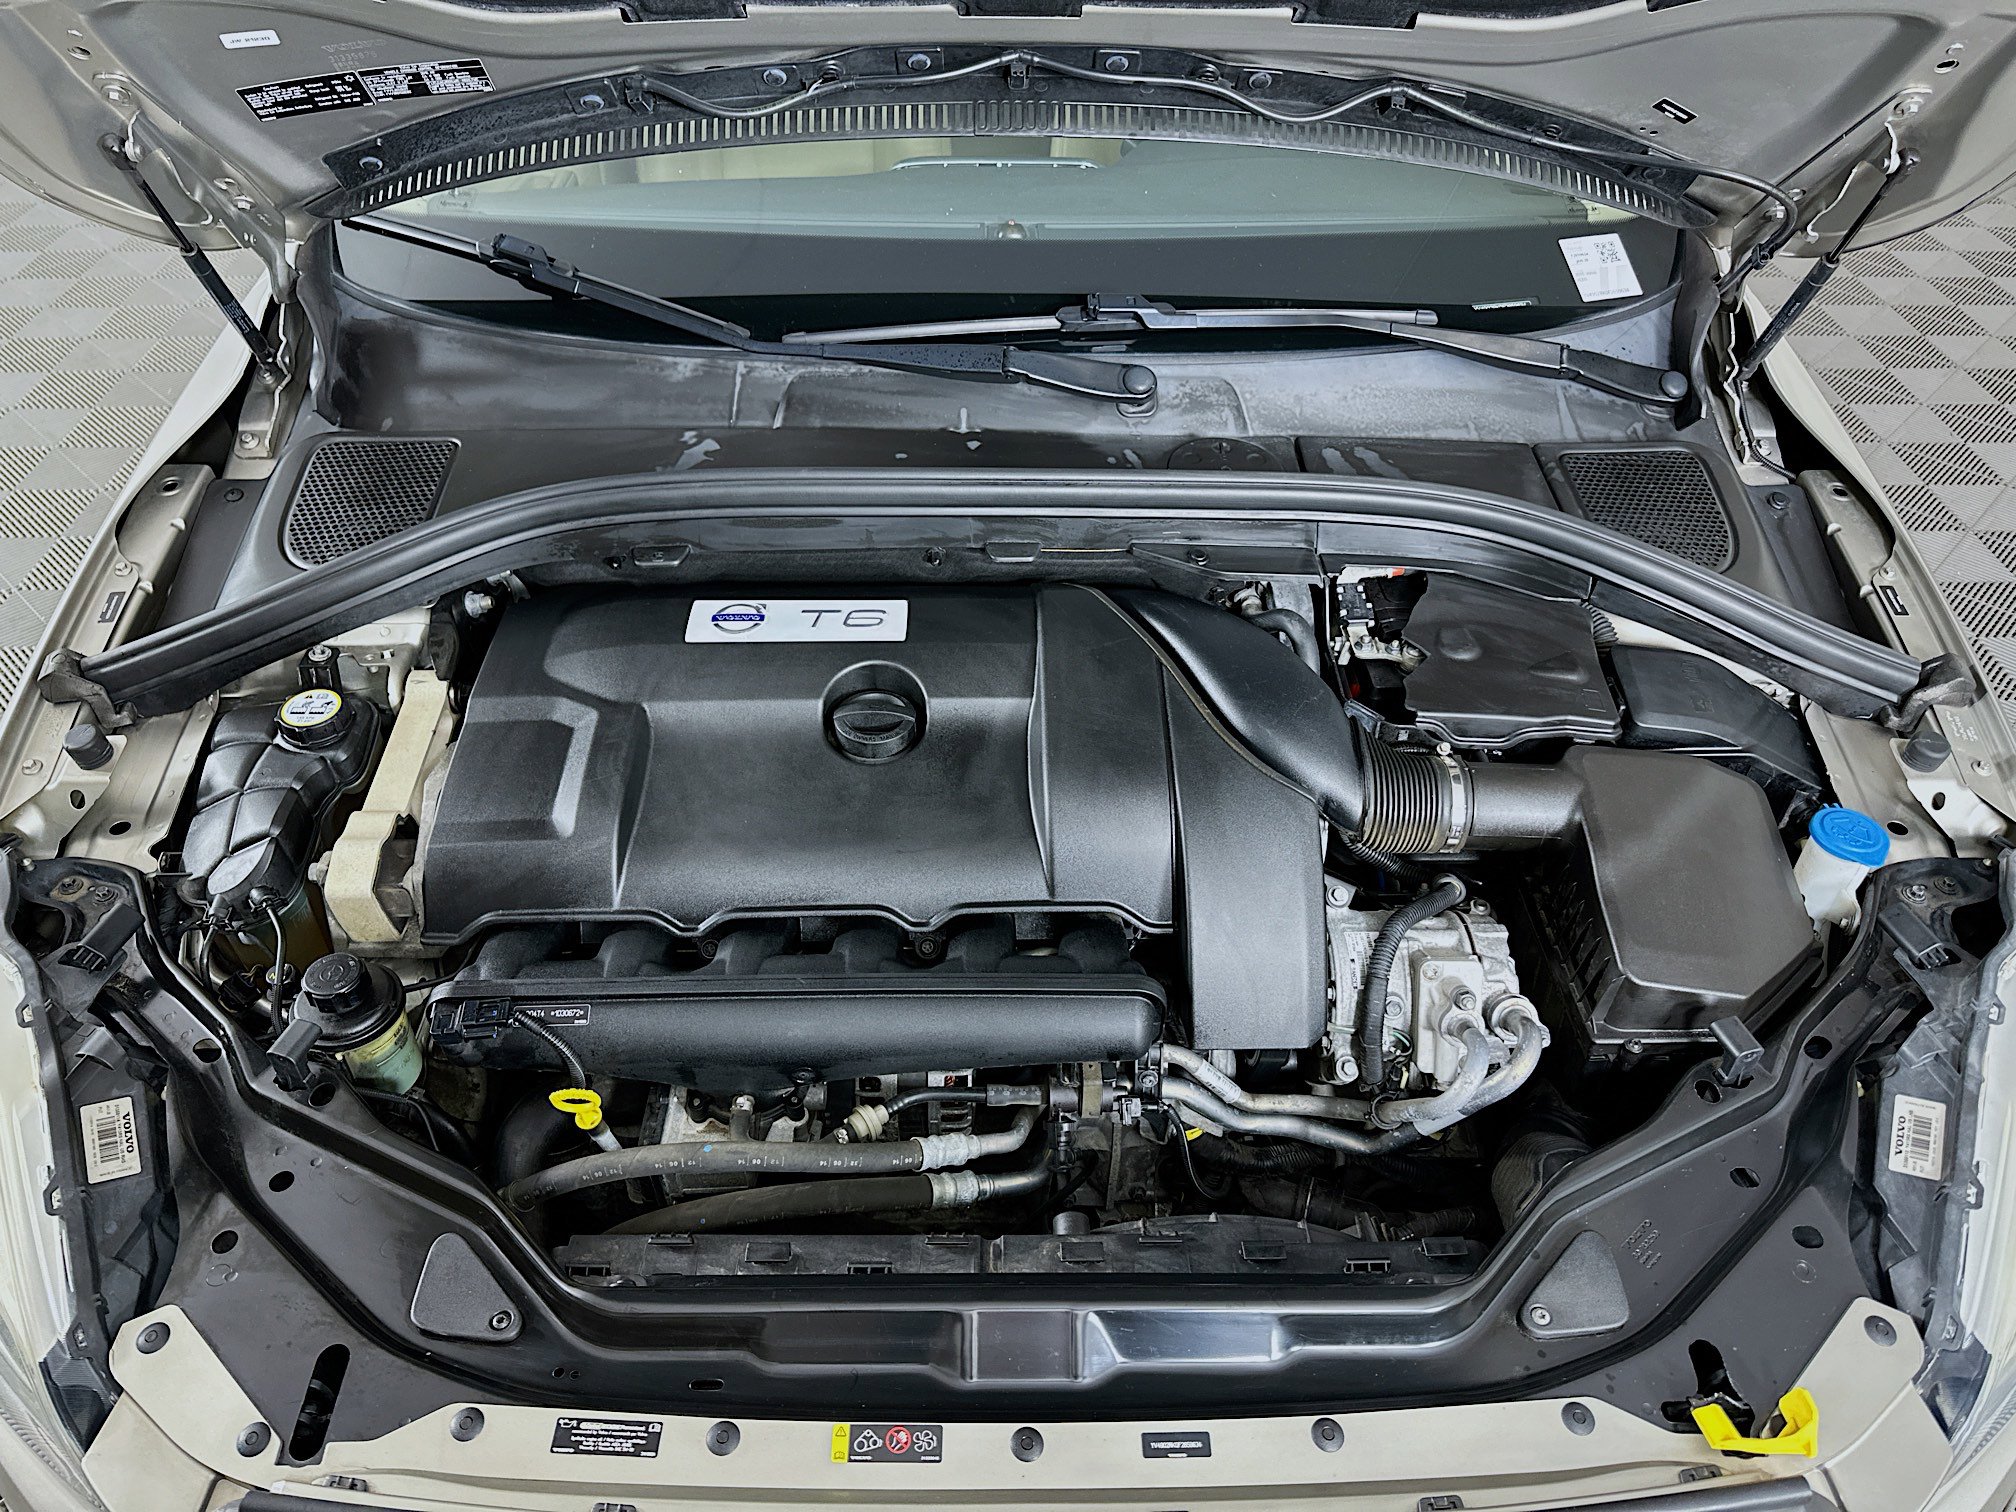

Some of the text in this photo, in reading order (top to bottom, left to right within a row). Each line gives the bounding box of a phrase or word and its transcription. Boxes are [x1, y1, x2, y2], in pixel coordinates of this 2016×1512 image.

[801, 609, 887, 628] T6
[122, 1111, 134, 1153] VOLVO
[1895, 1116, 1906, 1156] VOLVO
